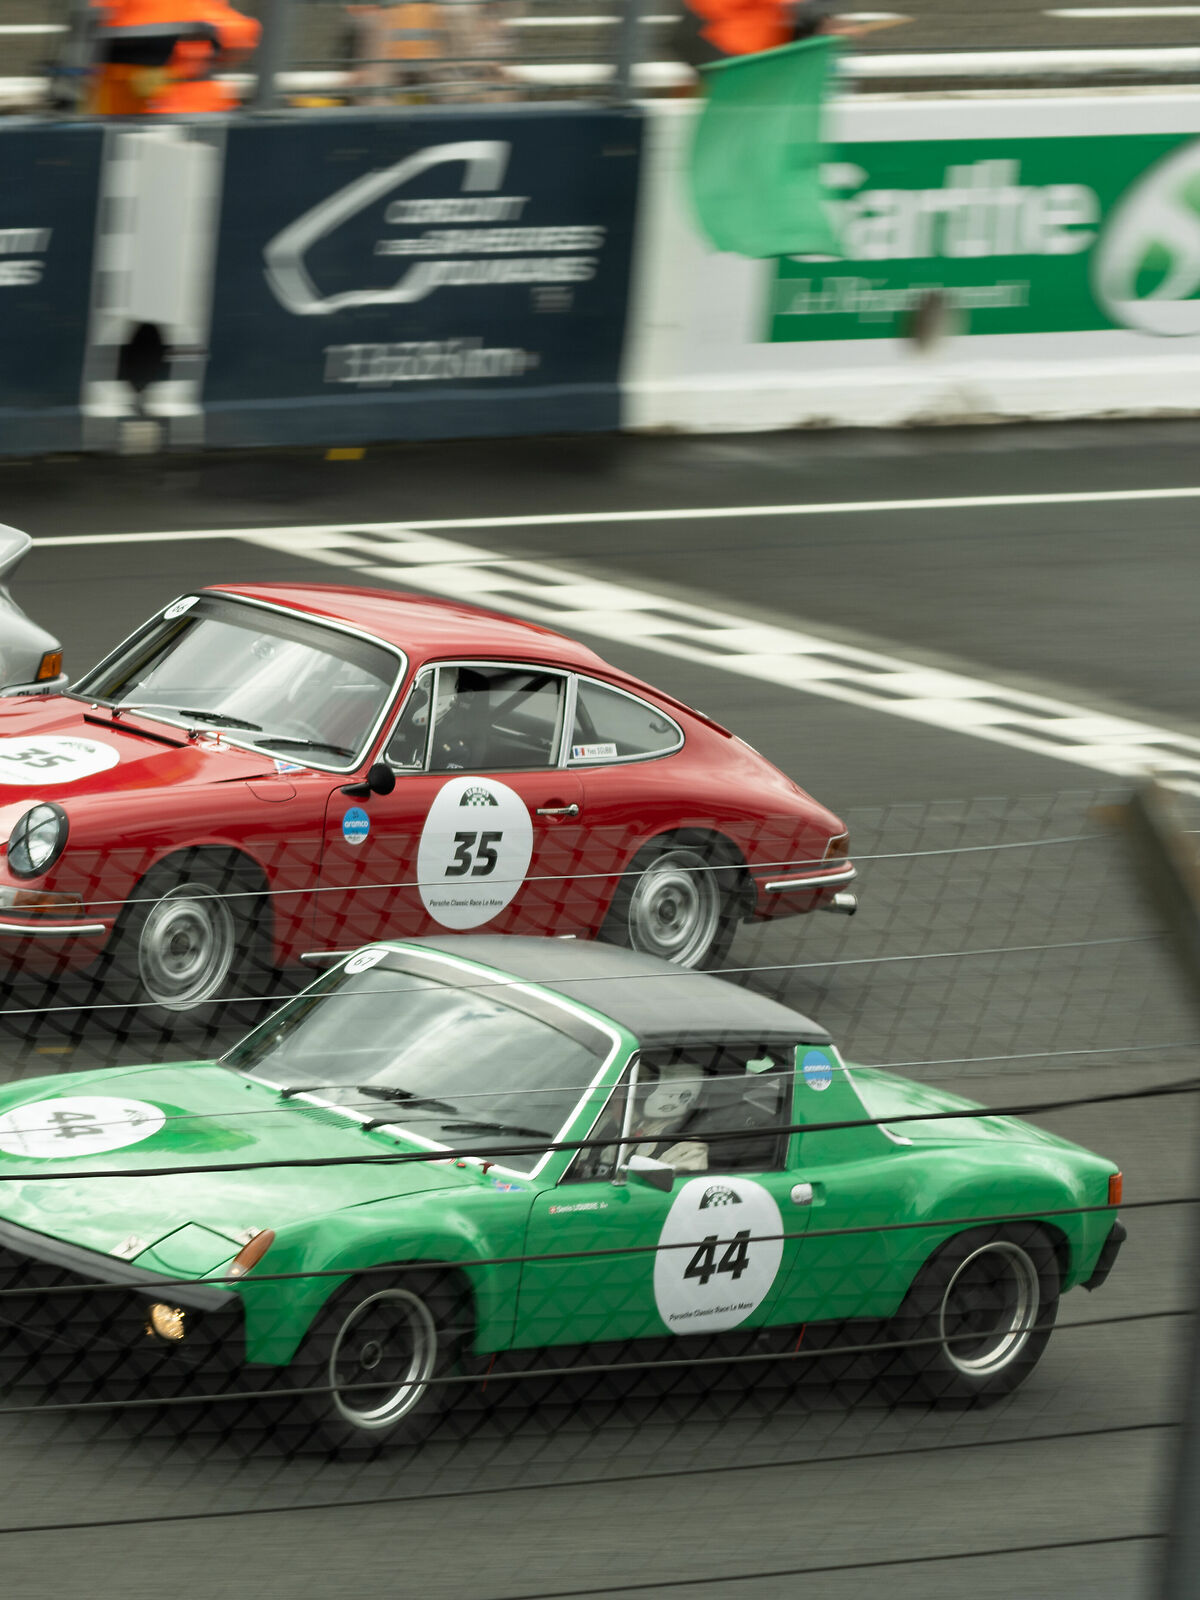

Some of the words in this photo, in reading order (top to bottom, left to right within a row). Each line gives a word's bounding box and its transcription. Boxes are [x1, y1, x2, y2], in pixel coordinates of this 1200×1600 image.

[788, 158, 1100, 262] arthe
[444, 831, 504, 876] 35
[47, 1111, 104, 1139] 44
[683, 1229, 752, 1286] 44
